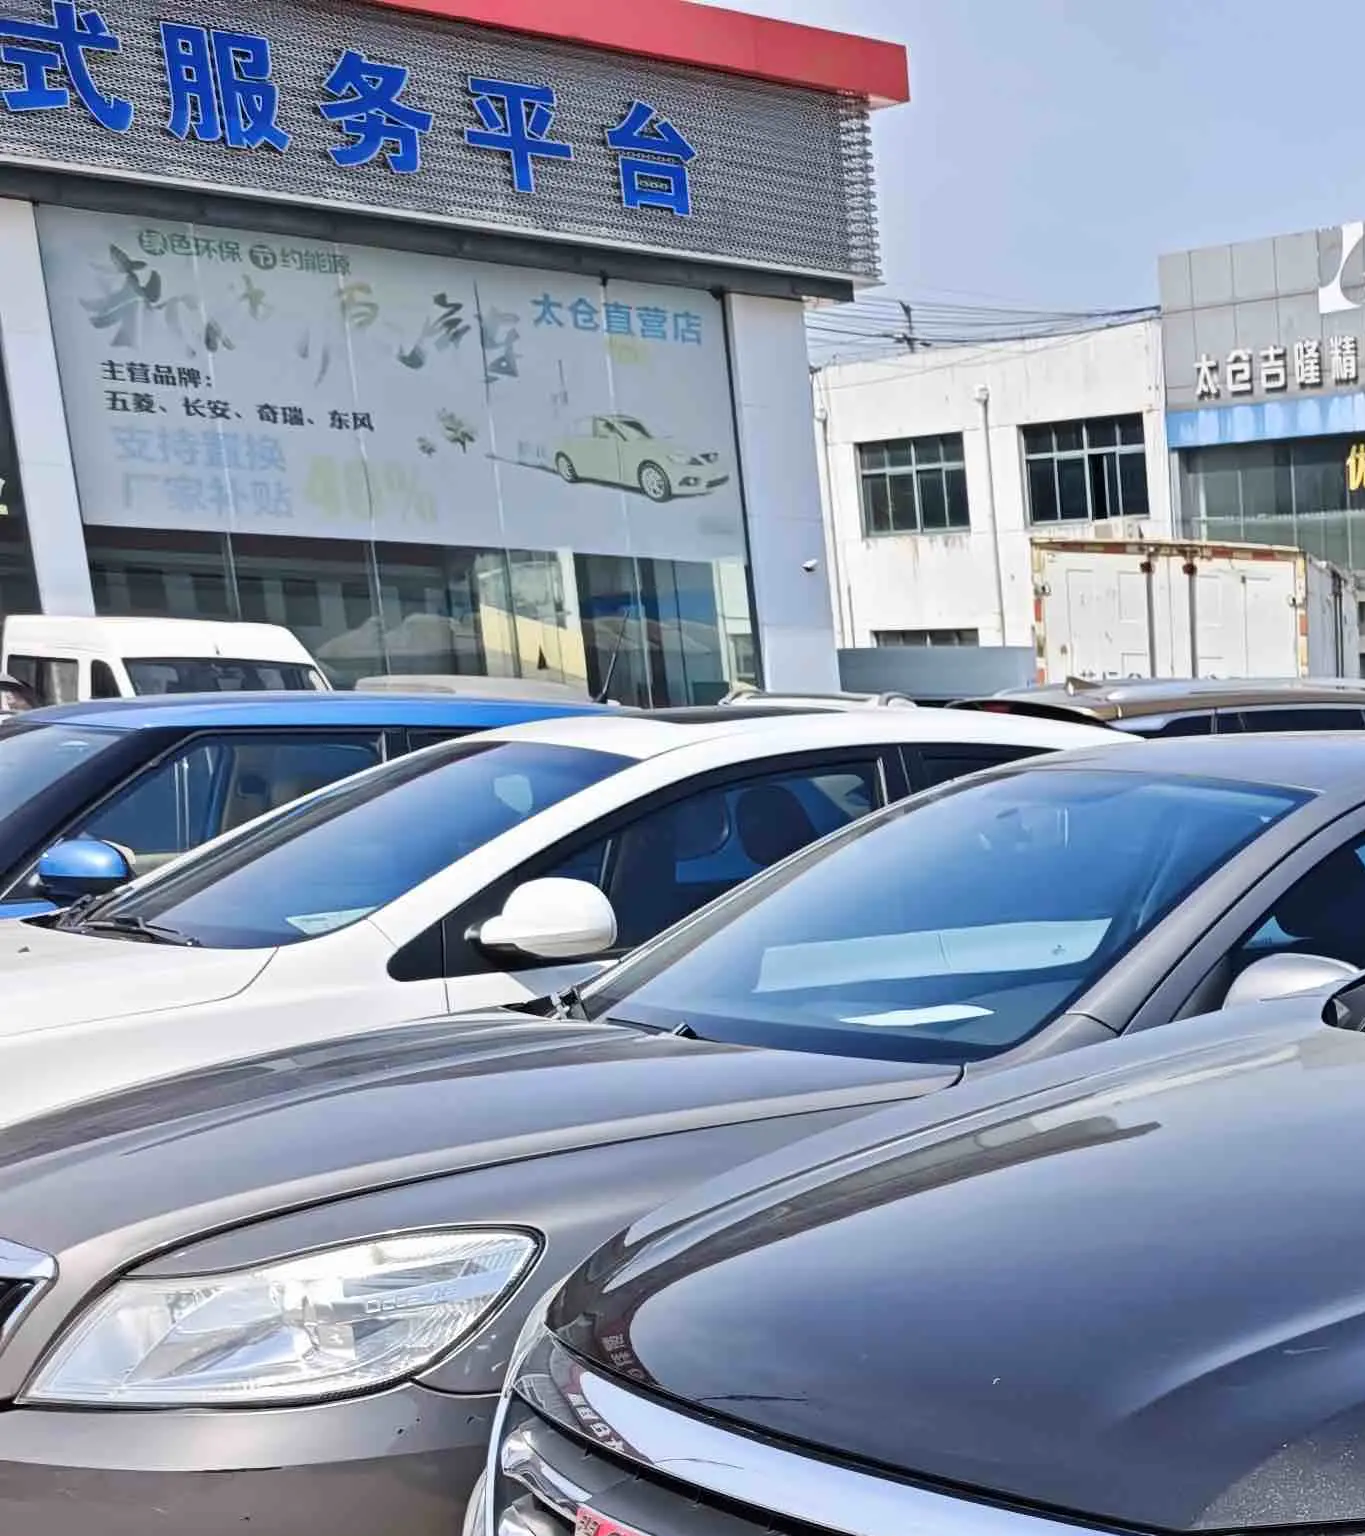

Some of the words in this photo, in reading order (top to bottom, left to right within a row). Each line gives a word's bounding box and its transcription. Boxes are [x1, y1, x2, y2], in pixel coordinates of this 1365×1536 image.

[530, 292, 702, 345] 太仓直营店
